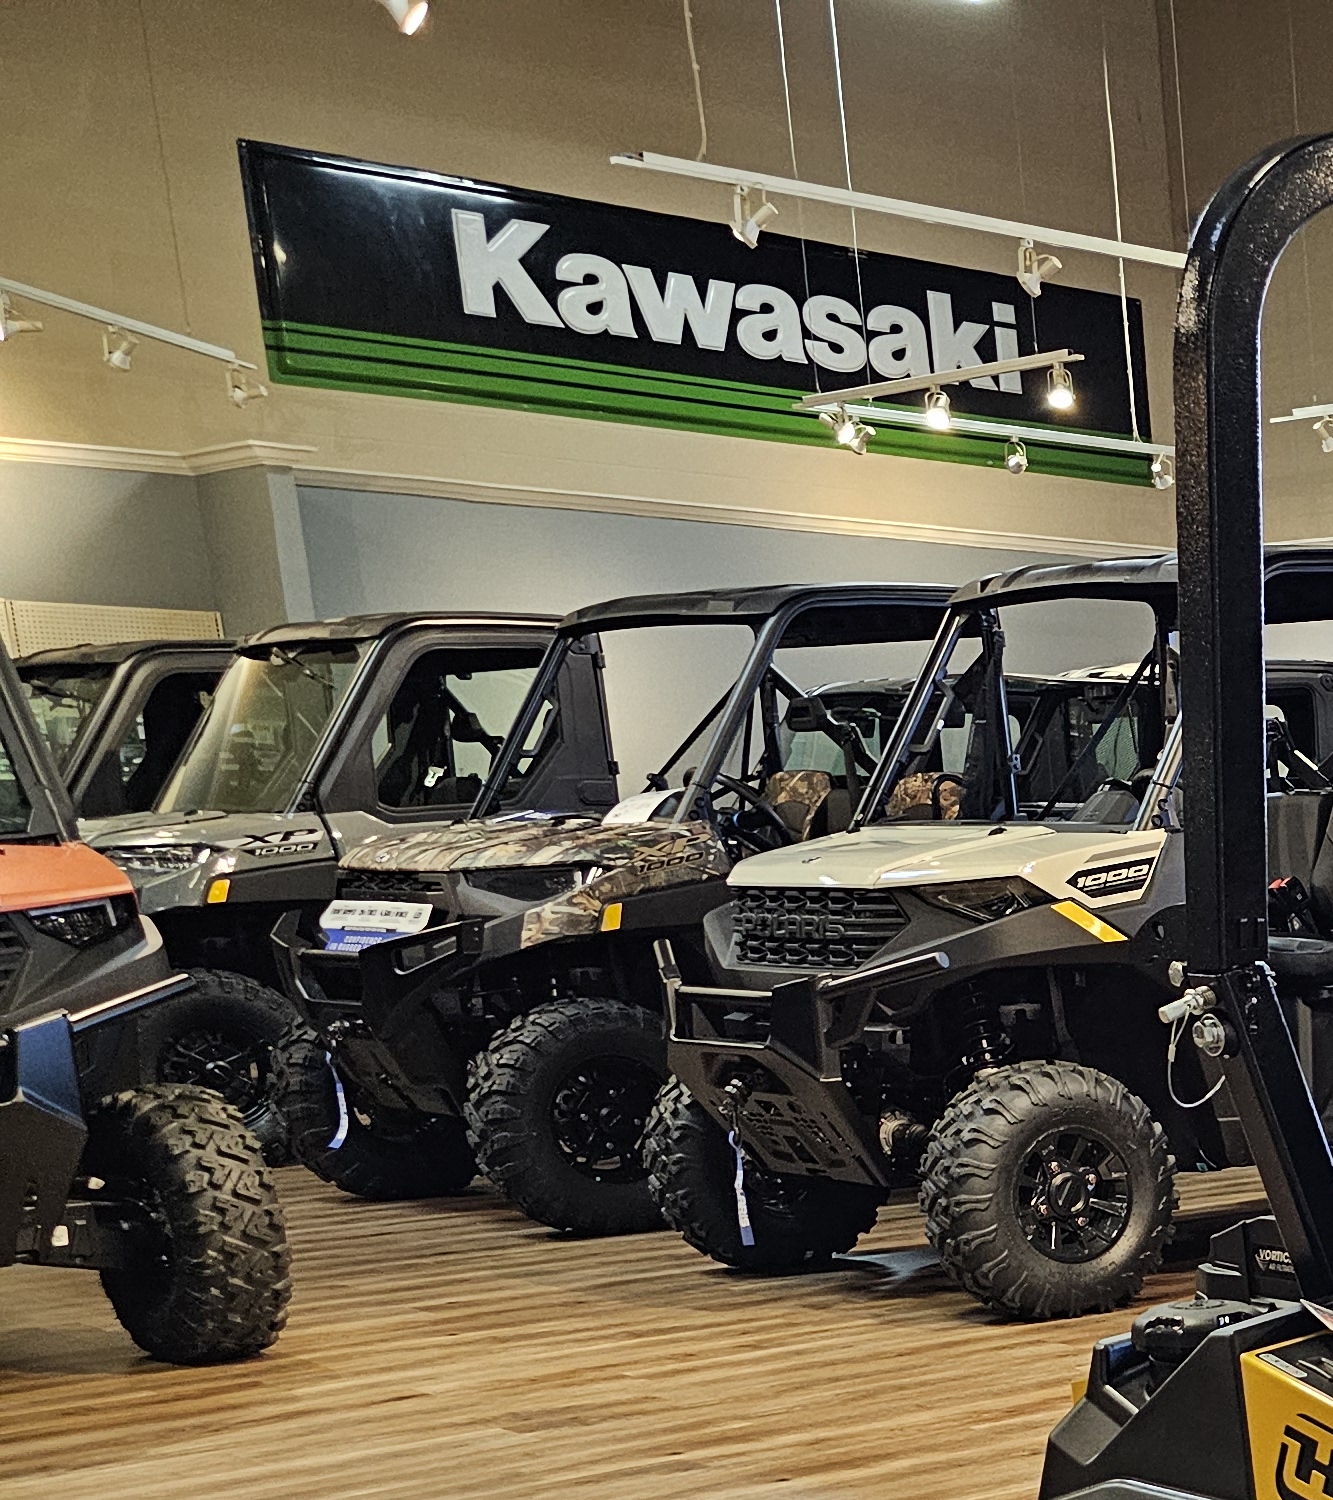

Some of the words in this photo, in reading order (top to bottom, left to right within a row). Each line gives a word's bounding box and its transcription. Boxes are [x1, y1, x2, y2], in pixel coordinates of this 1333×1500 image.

[451, 208, 1023, 396] Kawasaki
[239, 828, 320, 847] XP
[631, 833, 713, 863] XP
[255, 843, 315, 856] 1000
[638, 851, 704, 874] 1000
[1076, 864, 1150, 888] 1000
[741, 912, 845, 939] POLARIS
[1259, 1249, 1292, 1263] VORTIC
